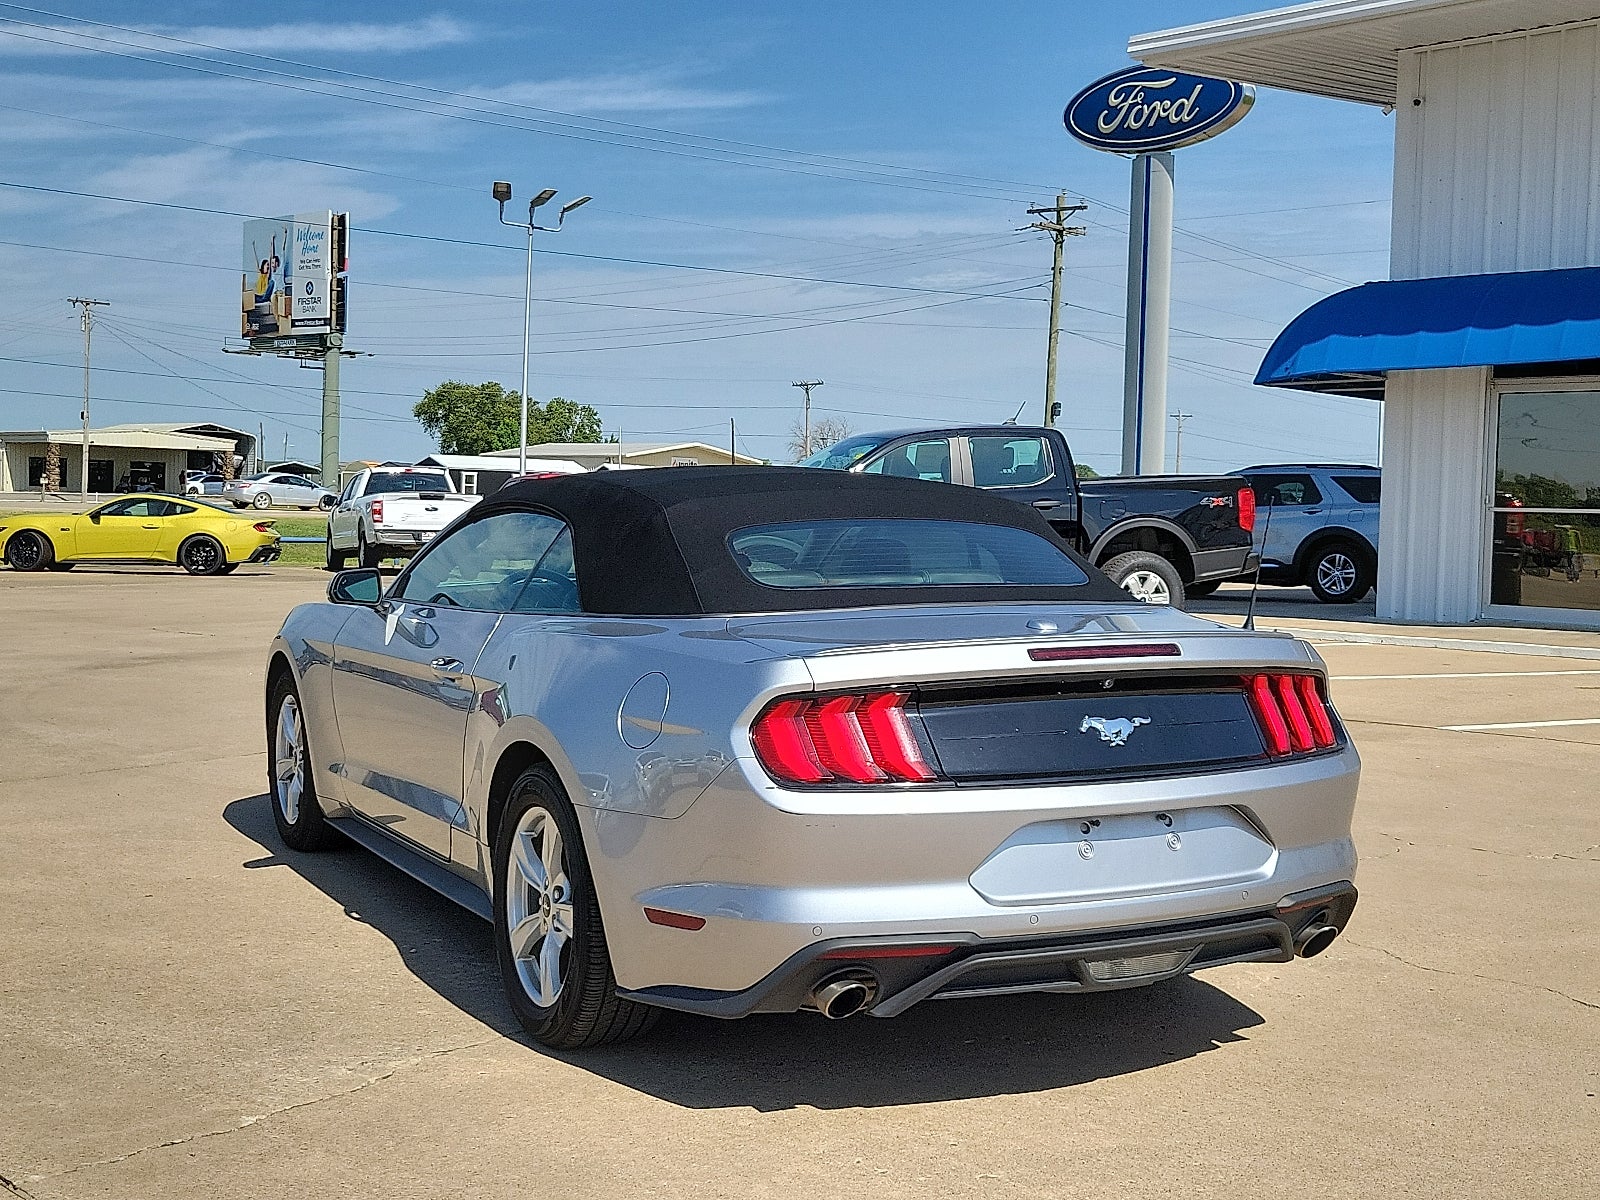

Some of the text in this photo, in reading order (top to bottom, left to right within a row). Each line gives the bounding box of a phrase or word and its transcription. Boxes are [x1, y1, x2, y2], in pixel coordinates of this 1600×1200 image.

[1097, 77, 1203, 134] Ford
[296, 224, 324, 242] Welcome
[301, 241, 319, 256] Home
[297, 296, 322, 305] FIRSTAR
[302, 305, 317, 313] BANK
